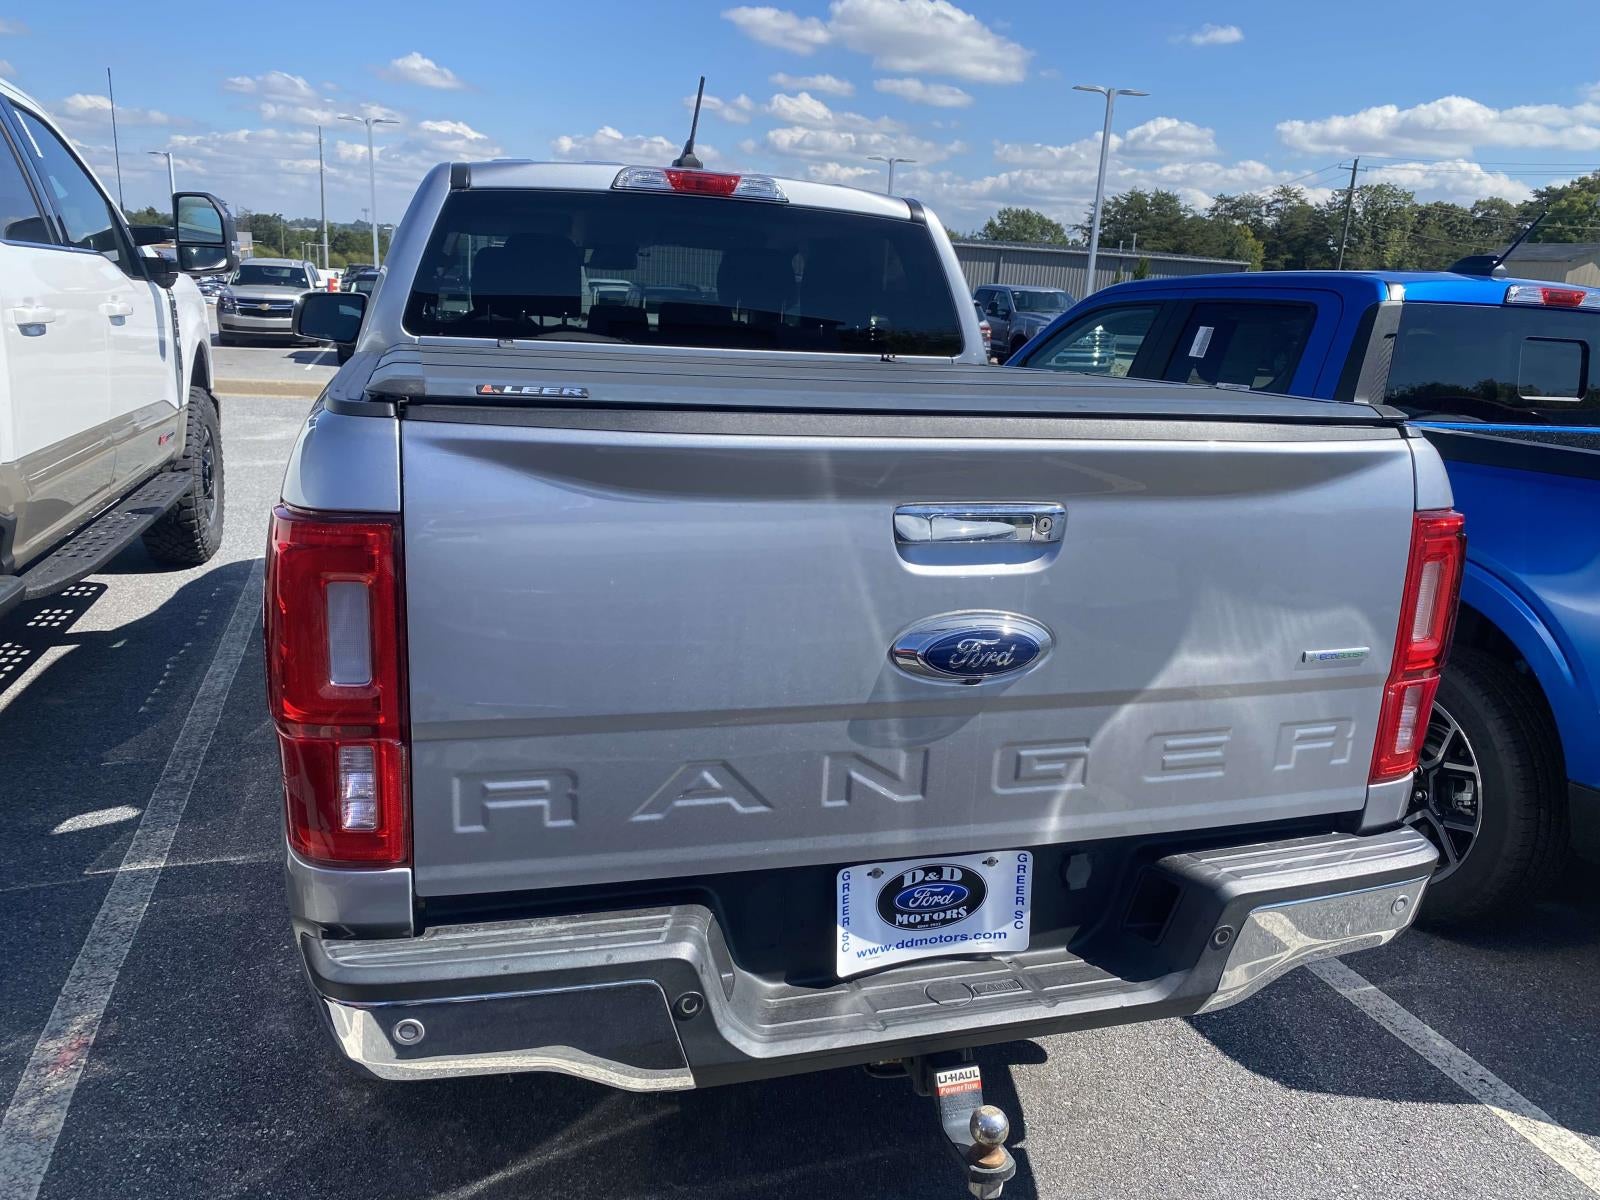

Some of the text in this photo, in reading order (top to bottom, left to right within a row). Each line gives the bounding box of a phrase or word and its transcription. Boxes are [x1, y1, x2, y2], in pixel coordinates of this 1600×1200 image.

[503, 385, 585, 396] LEER
[949, 638, 1016, 669] Ford
[452, 718, 1355, 834] RANGER
[902, 867, 963, 888] D&D
[909, 887, 954, 907] Ford
[1014, 853, 1028, 930] GREER SC
[841, 871, 851, 953] GREER SC
[895, 905, 968, 926] MOTORS
[856, 931, 1007, 959] www.ddmotors.com
[938, 1070, 979, 1084] U-HAUL
